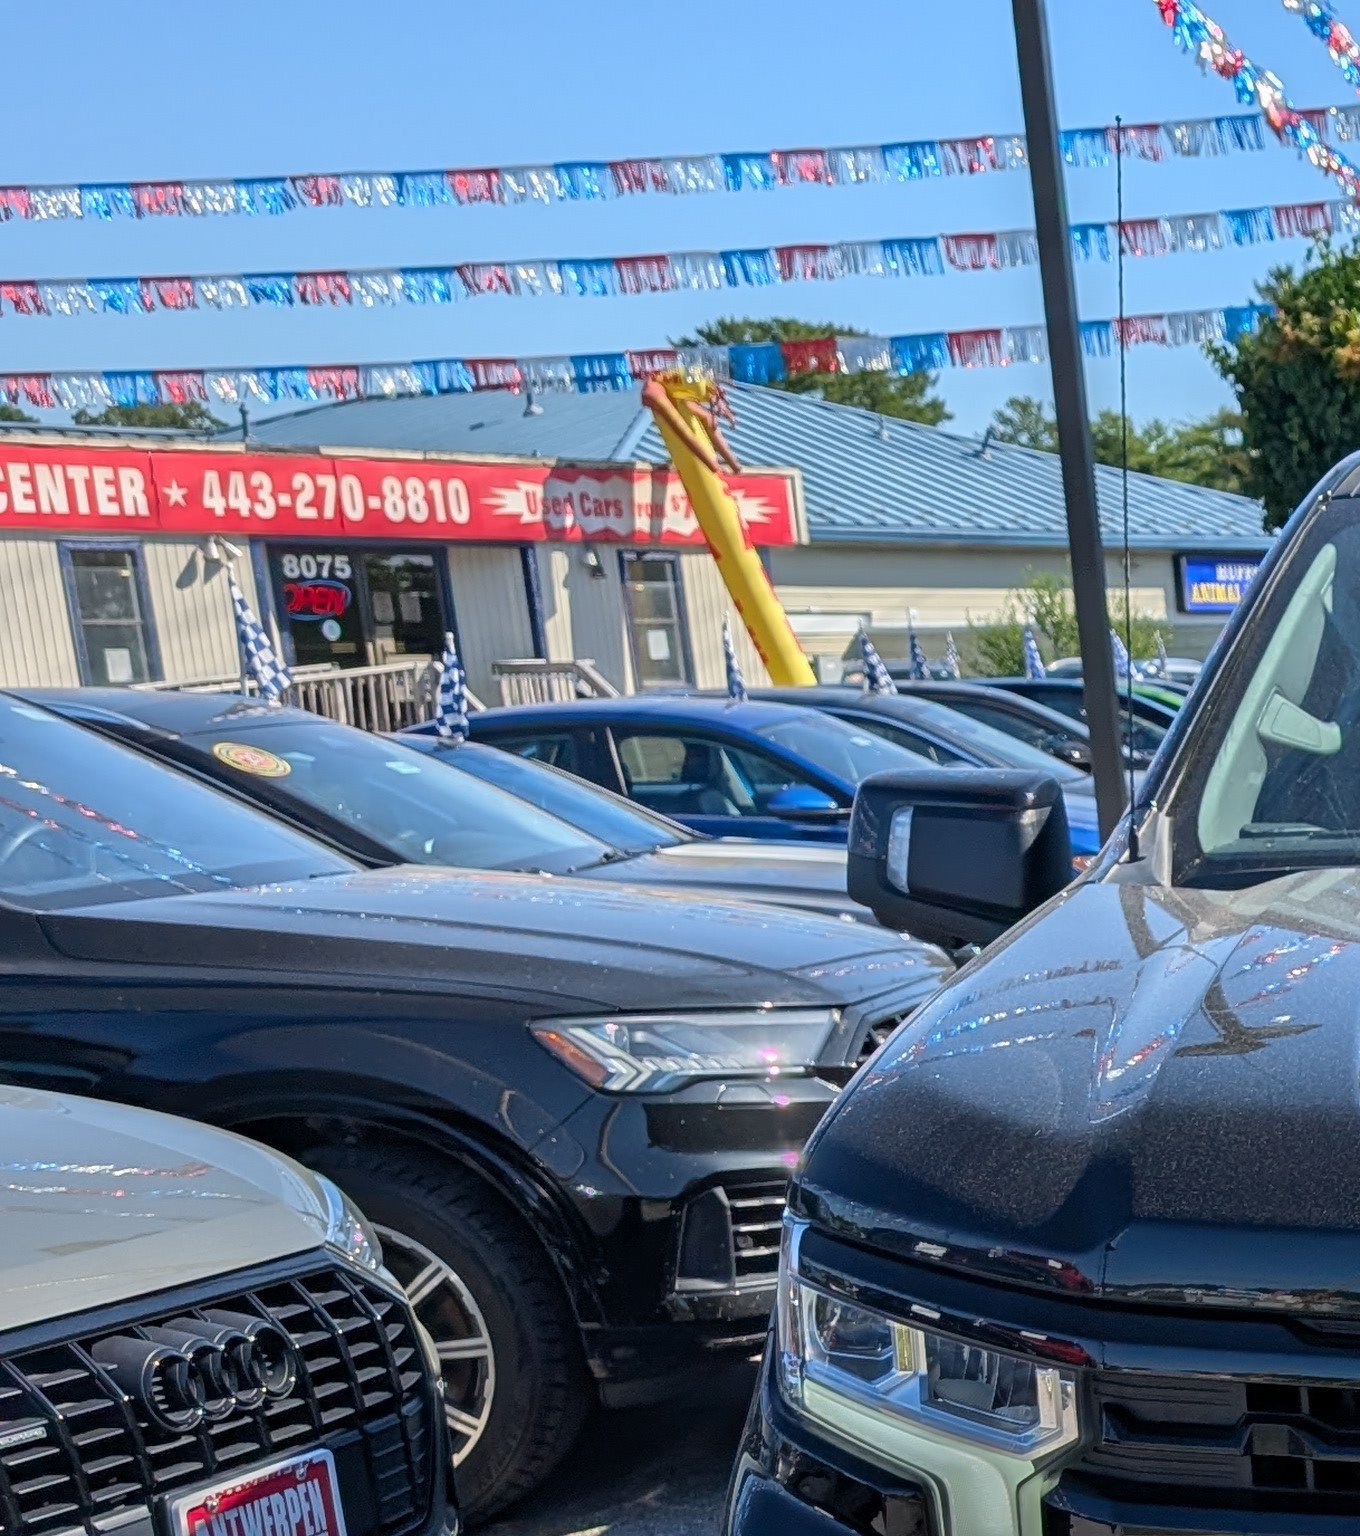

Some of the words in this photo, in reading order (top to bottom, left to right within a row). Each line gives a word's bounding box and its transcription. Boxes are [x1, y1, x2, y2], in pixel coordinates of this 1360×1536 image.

[202, 468, 470, 526] 443-270-8810
[525, 489, 574, 517] Used
[579, 490, 624, 519] Cars
[282, 553, 352, 579] 8075
